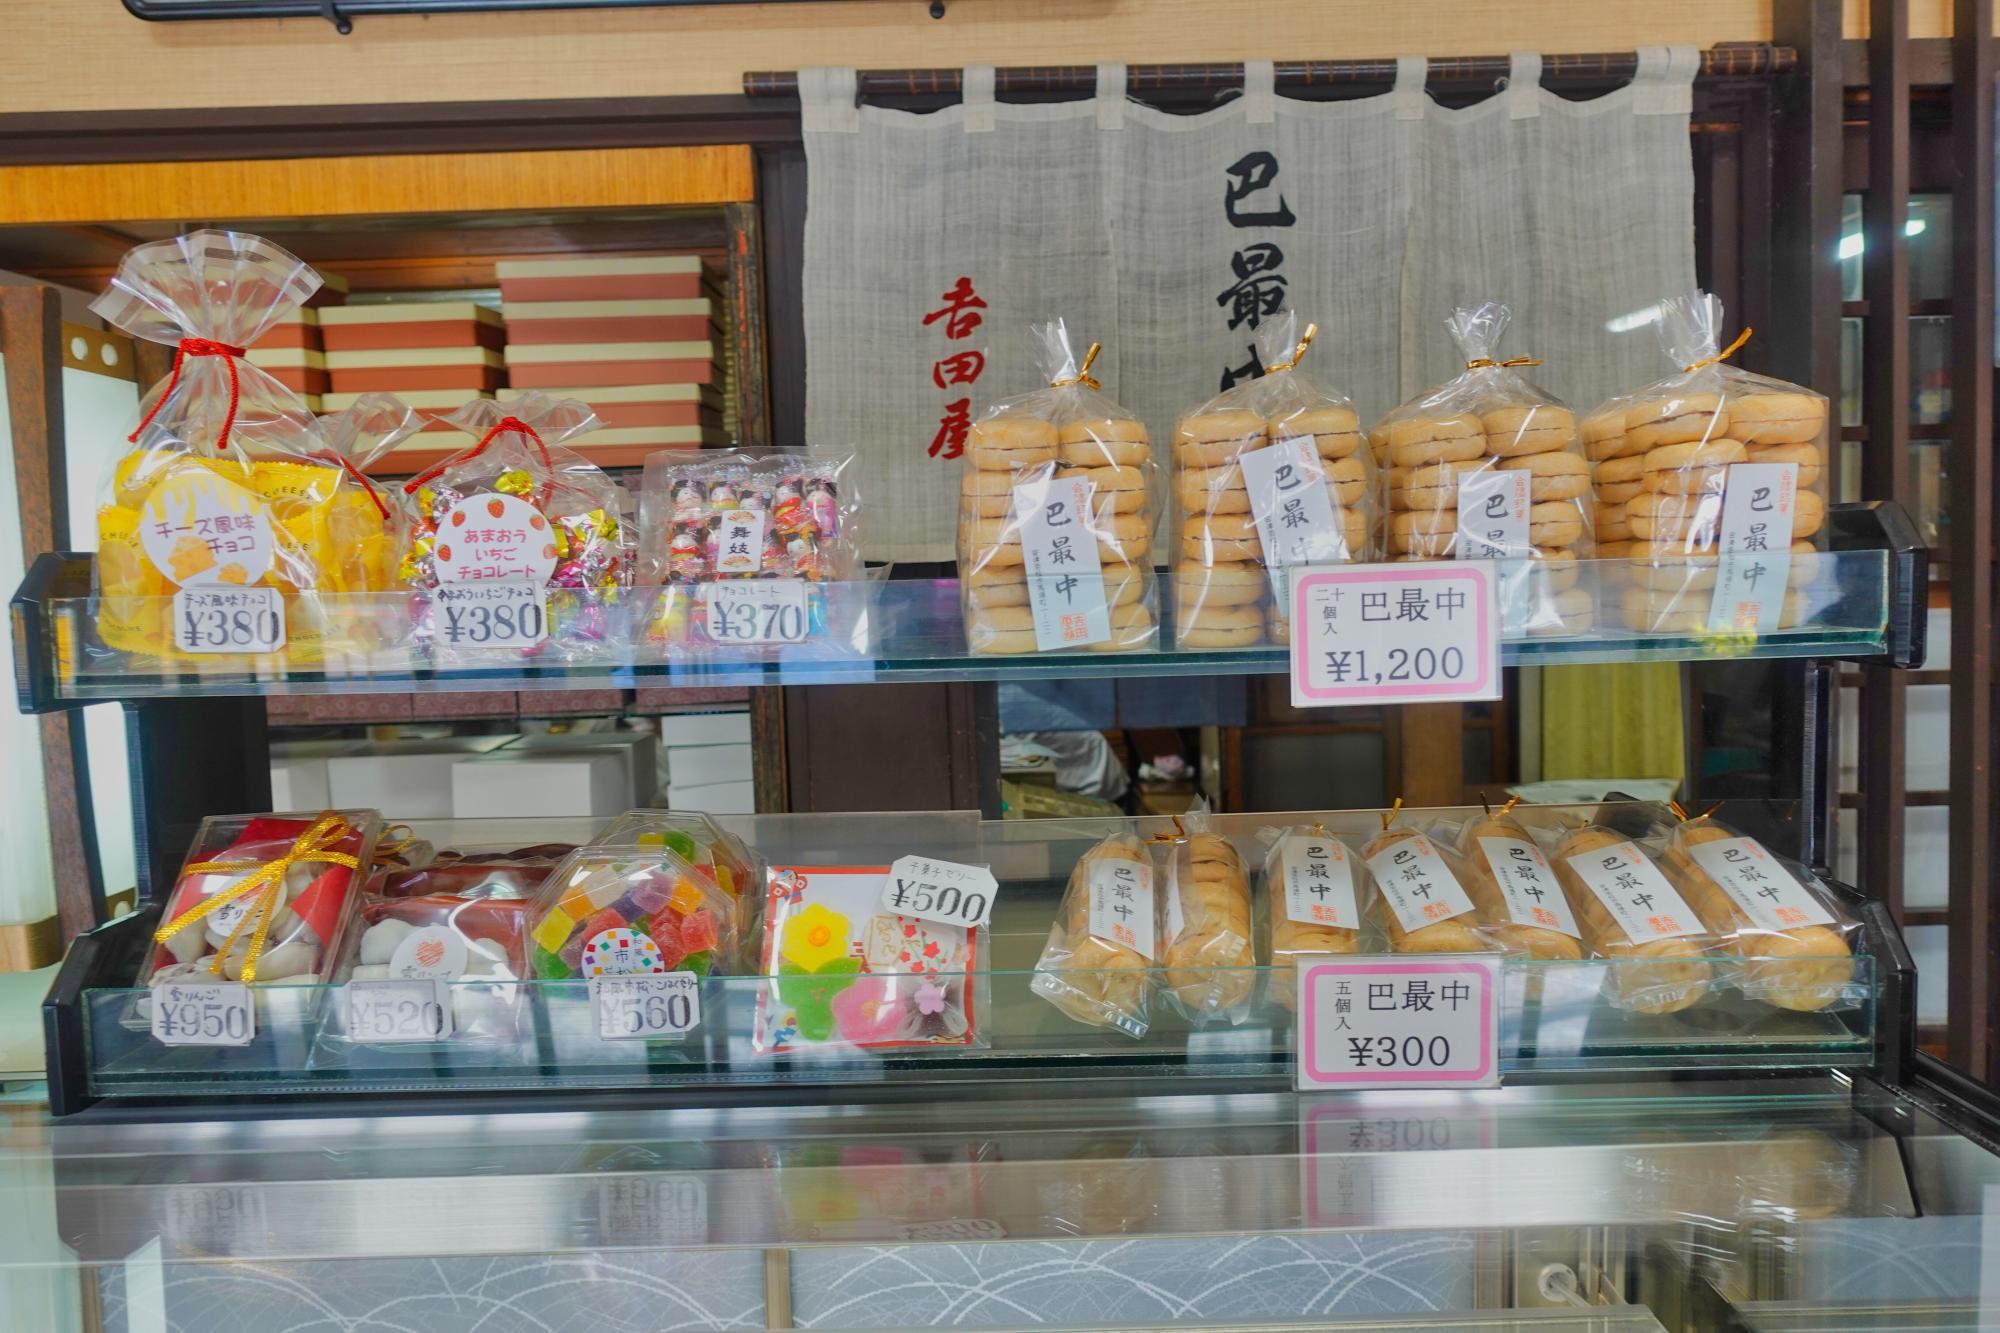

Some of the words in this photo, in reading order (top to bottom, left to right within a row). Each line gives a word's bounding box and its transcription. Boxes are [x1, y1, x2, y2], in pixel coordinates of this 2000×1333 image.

[922, 277, 988, 460] 吉田屋
[155, 513, 256, 538] チーズ風味
[206, 536, 256, 554] チョコ
[463, 528, 527, 543] あまおう
[727, 525, 752, 555] 舞妓
[1743, 486, 1774, 592] 巴最中
[457, 564, 537, 580] チョコレート
[475, 546, 520, 561] いちご
[1045, 501, 1079, 606] 巴最中
[184, 592, 267, 609] チーズ風味チョコ
[437, 586, 535, 602] あまおういちごチョコ
[720, 585, 781, 598] チョコレート
[1361, 587, 1467, 623] 巴最中
[184, 609, 279, 647] ¥380
[444, 602, 542, 643] ¥380
[713, 601, 802, 641] ¥370
[1315, 587, 1345, 636] 二十個入
[1326, 646, 1464, 685] ¥1,200
[1305, 846, 1333, 901] 巴最中
[1393, 849, 1434, 900] 巴最中
[1509, 846, 1546, 904] 巴最中
[1601, 855, 1656, 912] 巴最中
[1722, 848, 1783, 904] 巴最中
[890, 878, 987, 922] ¥500
[1112, 867, 1136, 922] 巴最中
[599, 994, 691, 1033] ¥560
[1335, 981, 1351, 1031] 五個入
[1368, 980, 1470, 1012] 巴最中
[159, 1002, 247, 1039] ¥950
[350, 1001, 444, 1035] ¥520
[1348, 1035, 1450, 1067] ¥300
